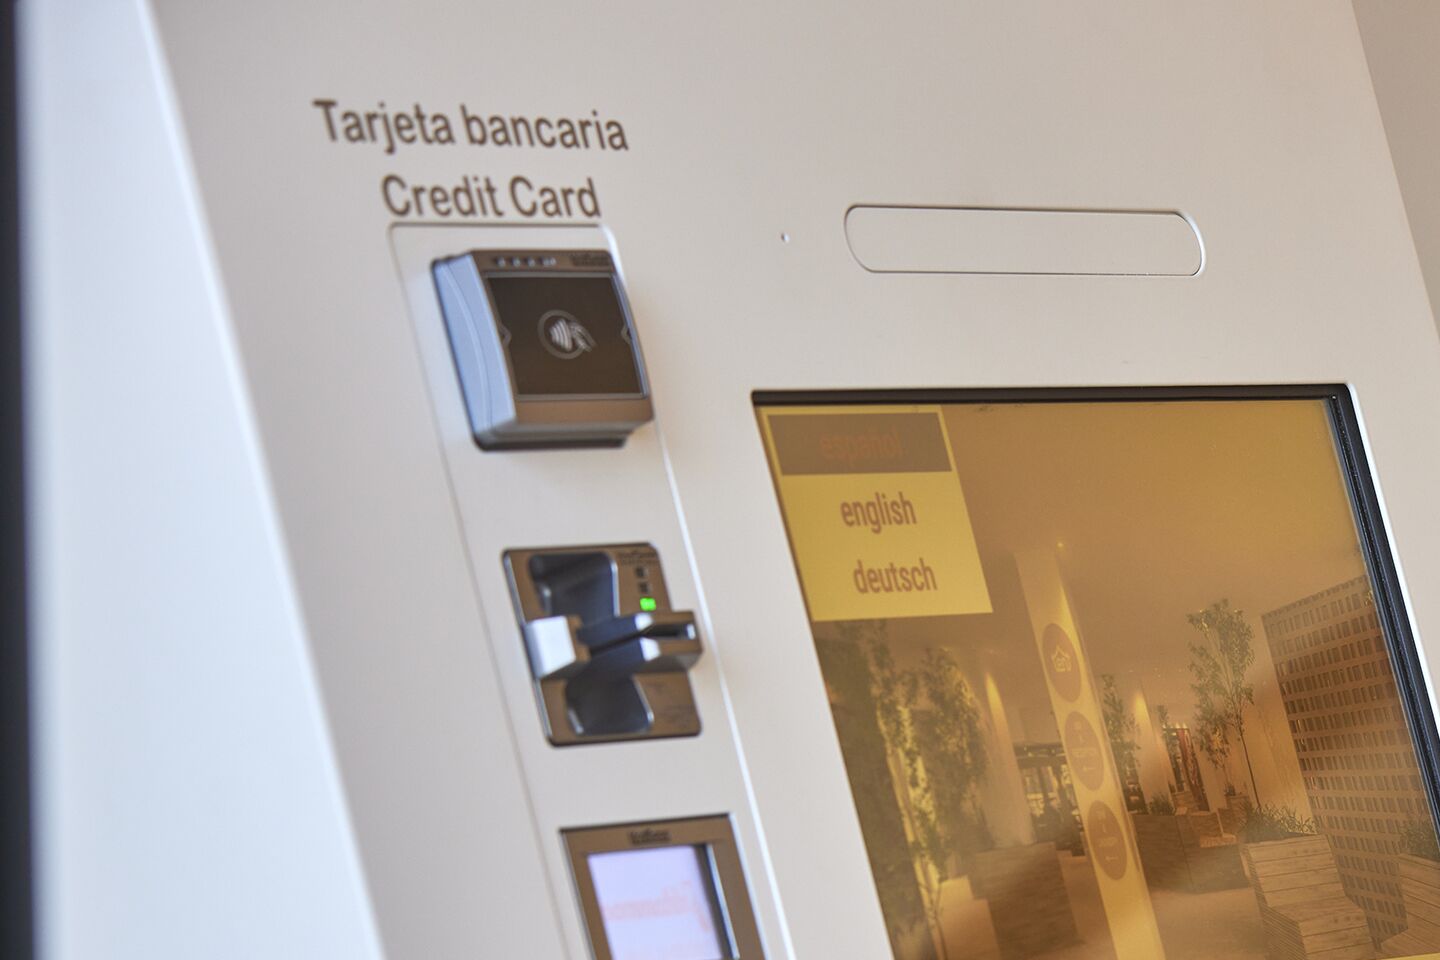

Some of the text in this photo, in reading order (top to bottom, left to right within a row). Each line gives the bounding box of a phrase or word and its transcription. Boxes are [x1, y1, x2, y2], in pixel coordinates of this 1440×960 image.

[313, 99, 629, 155] Tarjeta bancaria
[381, 174, 602, 218] Credit Card
[840, 491, 917, 535] english
[853, 557, 938, 594] deutsch
